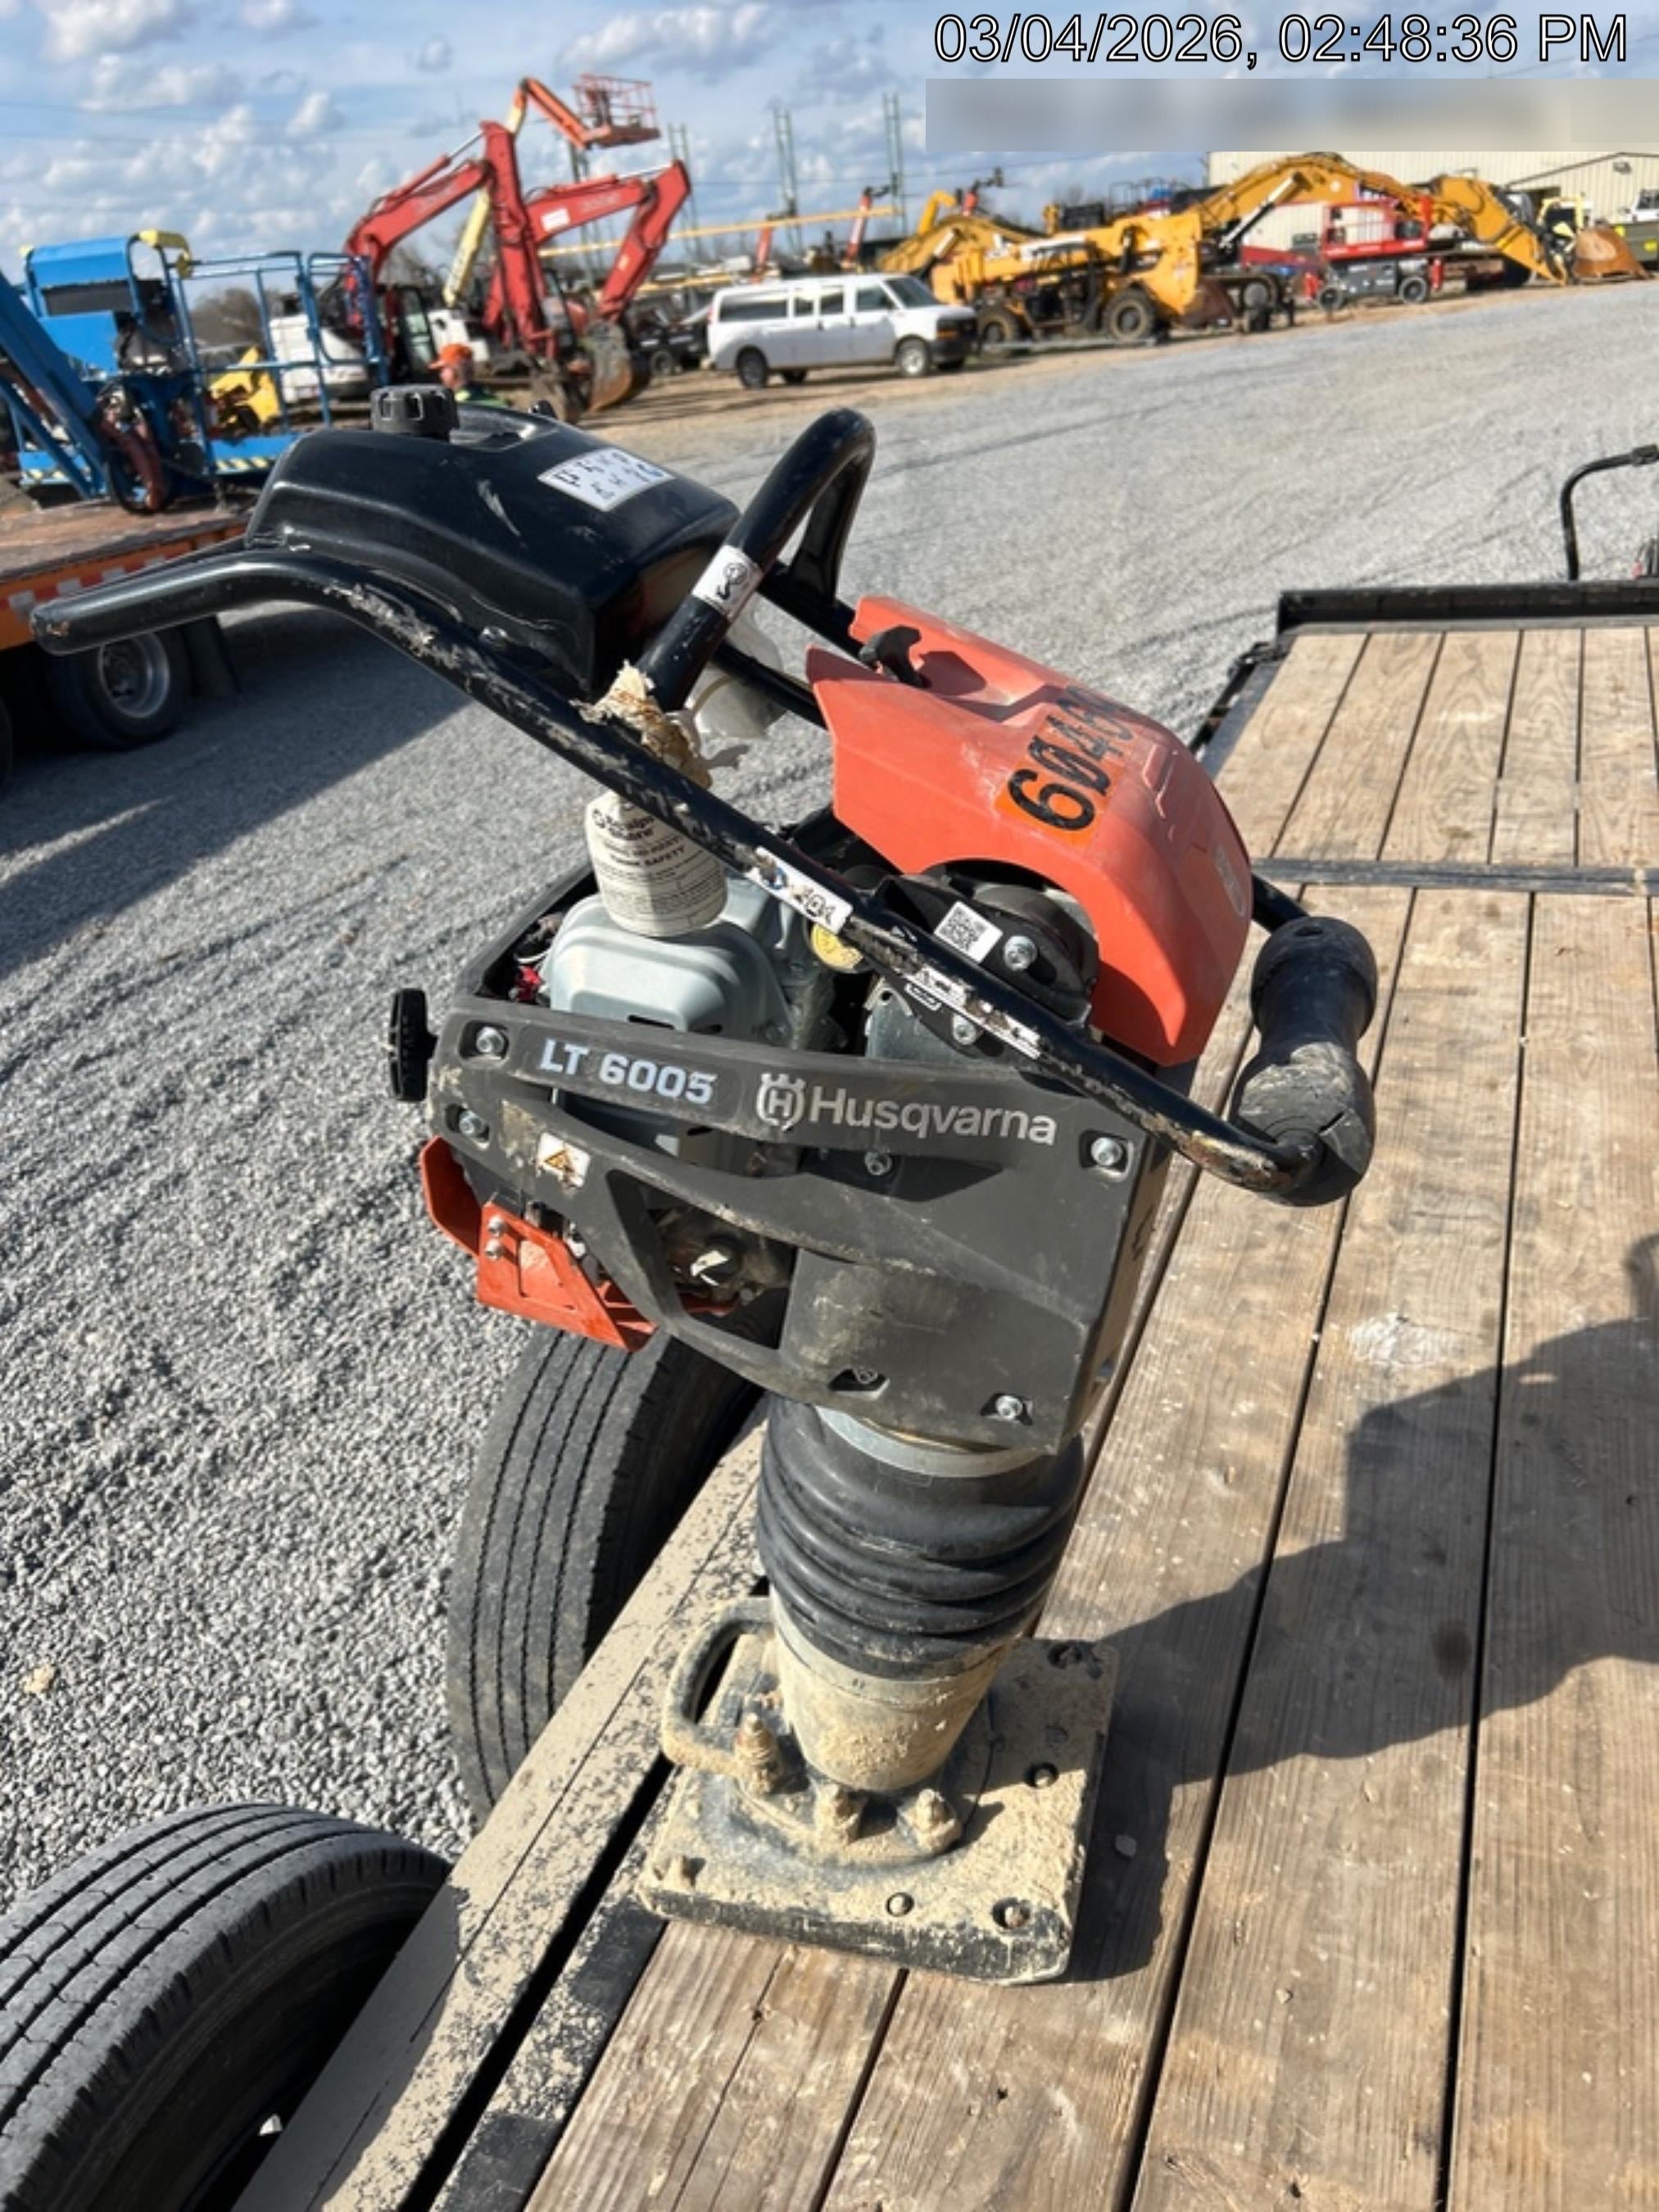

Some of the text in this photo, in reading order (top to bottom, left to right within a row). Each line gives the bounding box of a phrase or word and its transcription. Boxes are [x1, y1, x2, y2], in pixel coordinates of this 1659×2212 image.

[539, 1038, 718, 1104] LT 6005
[809, 1086, 1058, 1146] Husqvarna
